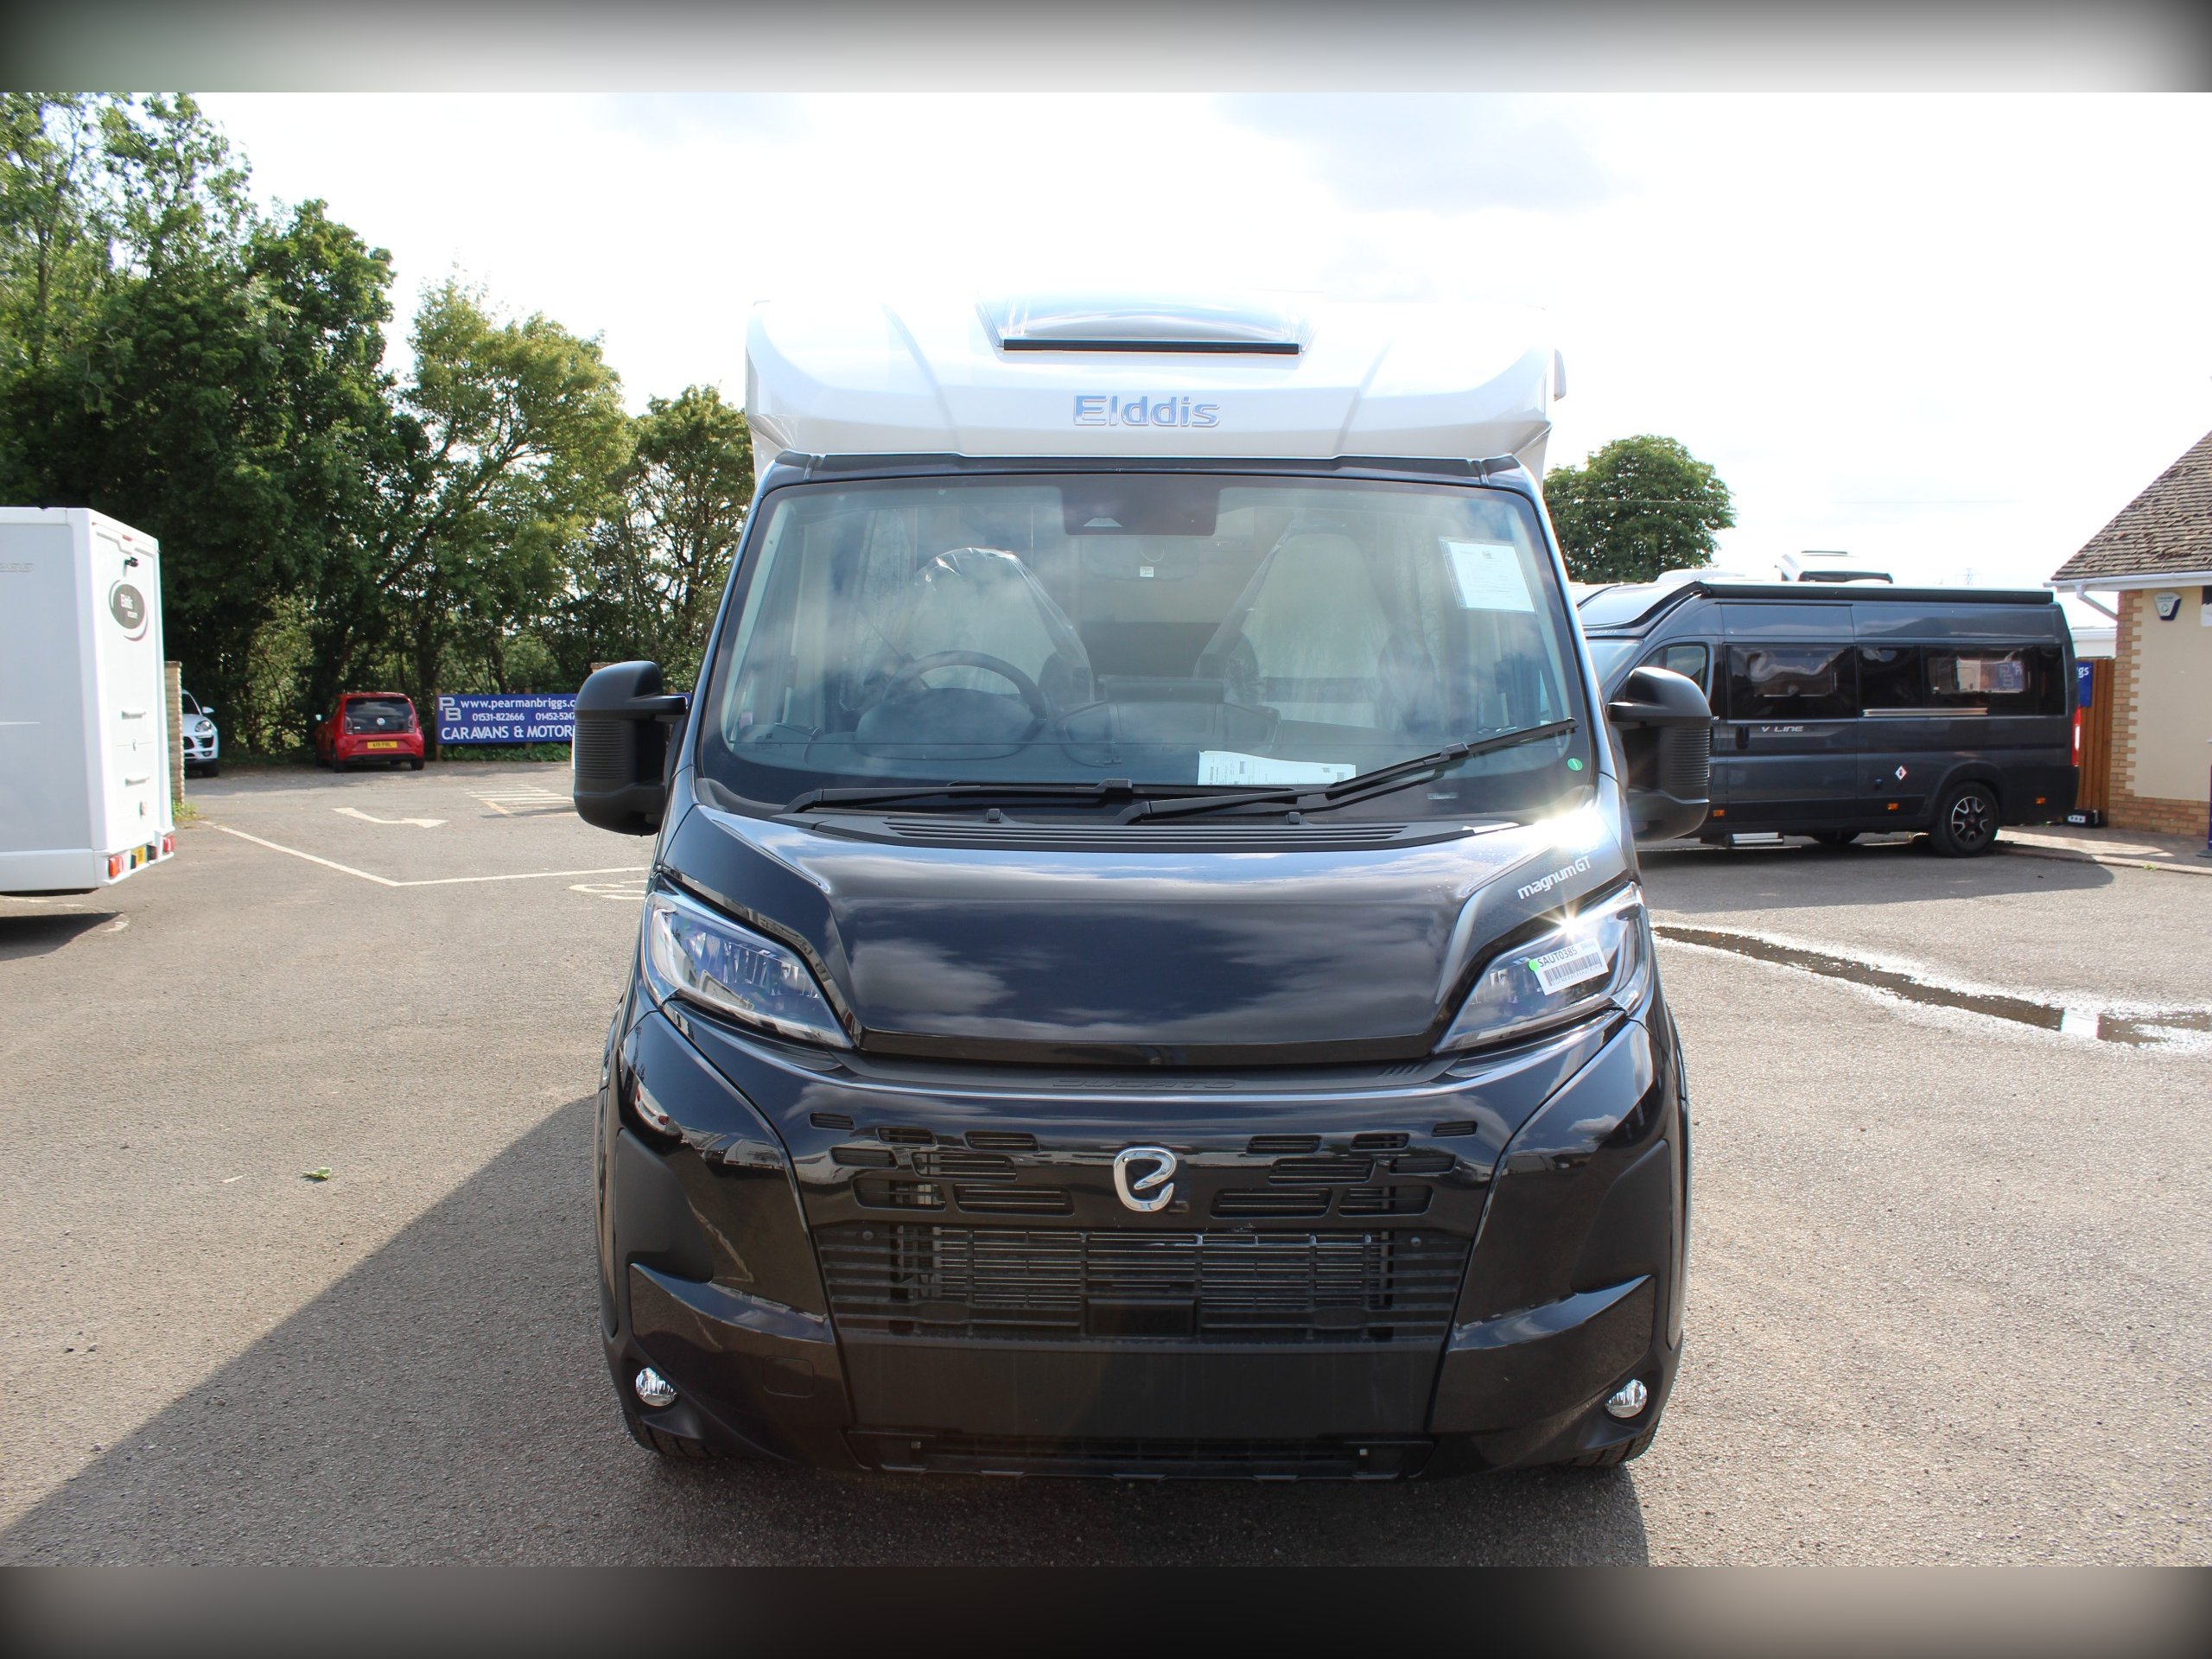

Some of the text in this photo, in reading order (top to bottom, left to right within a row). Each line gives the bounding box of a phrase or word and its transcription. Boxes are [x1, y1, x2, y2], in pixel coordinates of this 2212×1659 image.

[1073, 395, 1220, 428] Elddis
[472, 712, 524, 721] 01531-822666
[442, 725, 509, 741] CARAVANS
[513, 725, 524, 738] &
[1517, 855, 1591, 899] magnum GT
[1052, 1078, 1236, 1089] DUCATO
